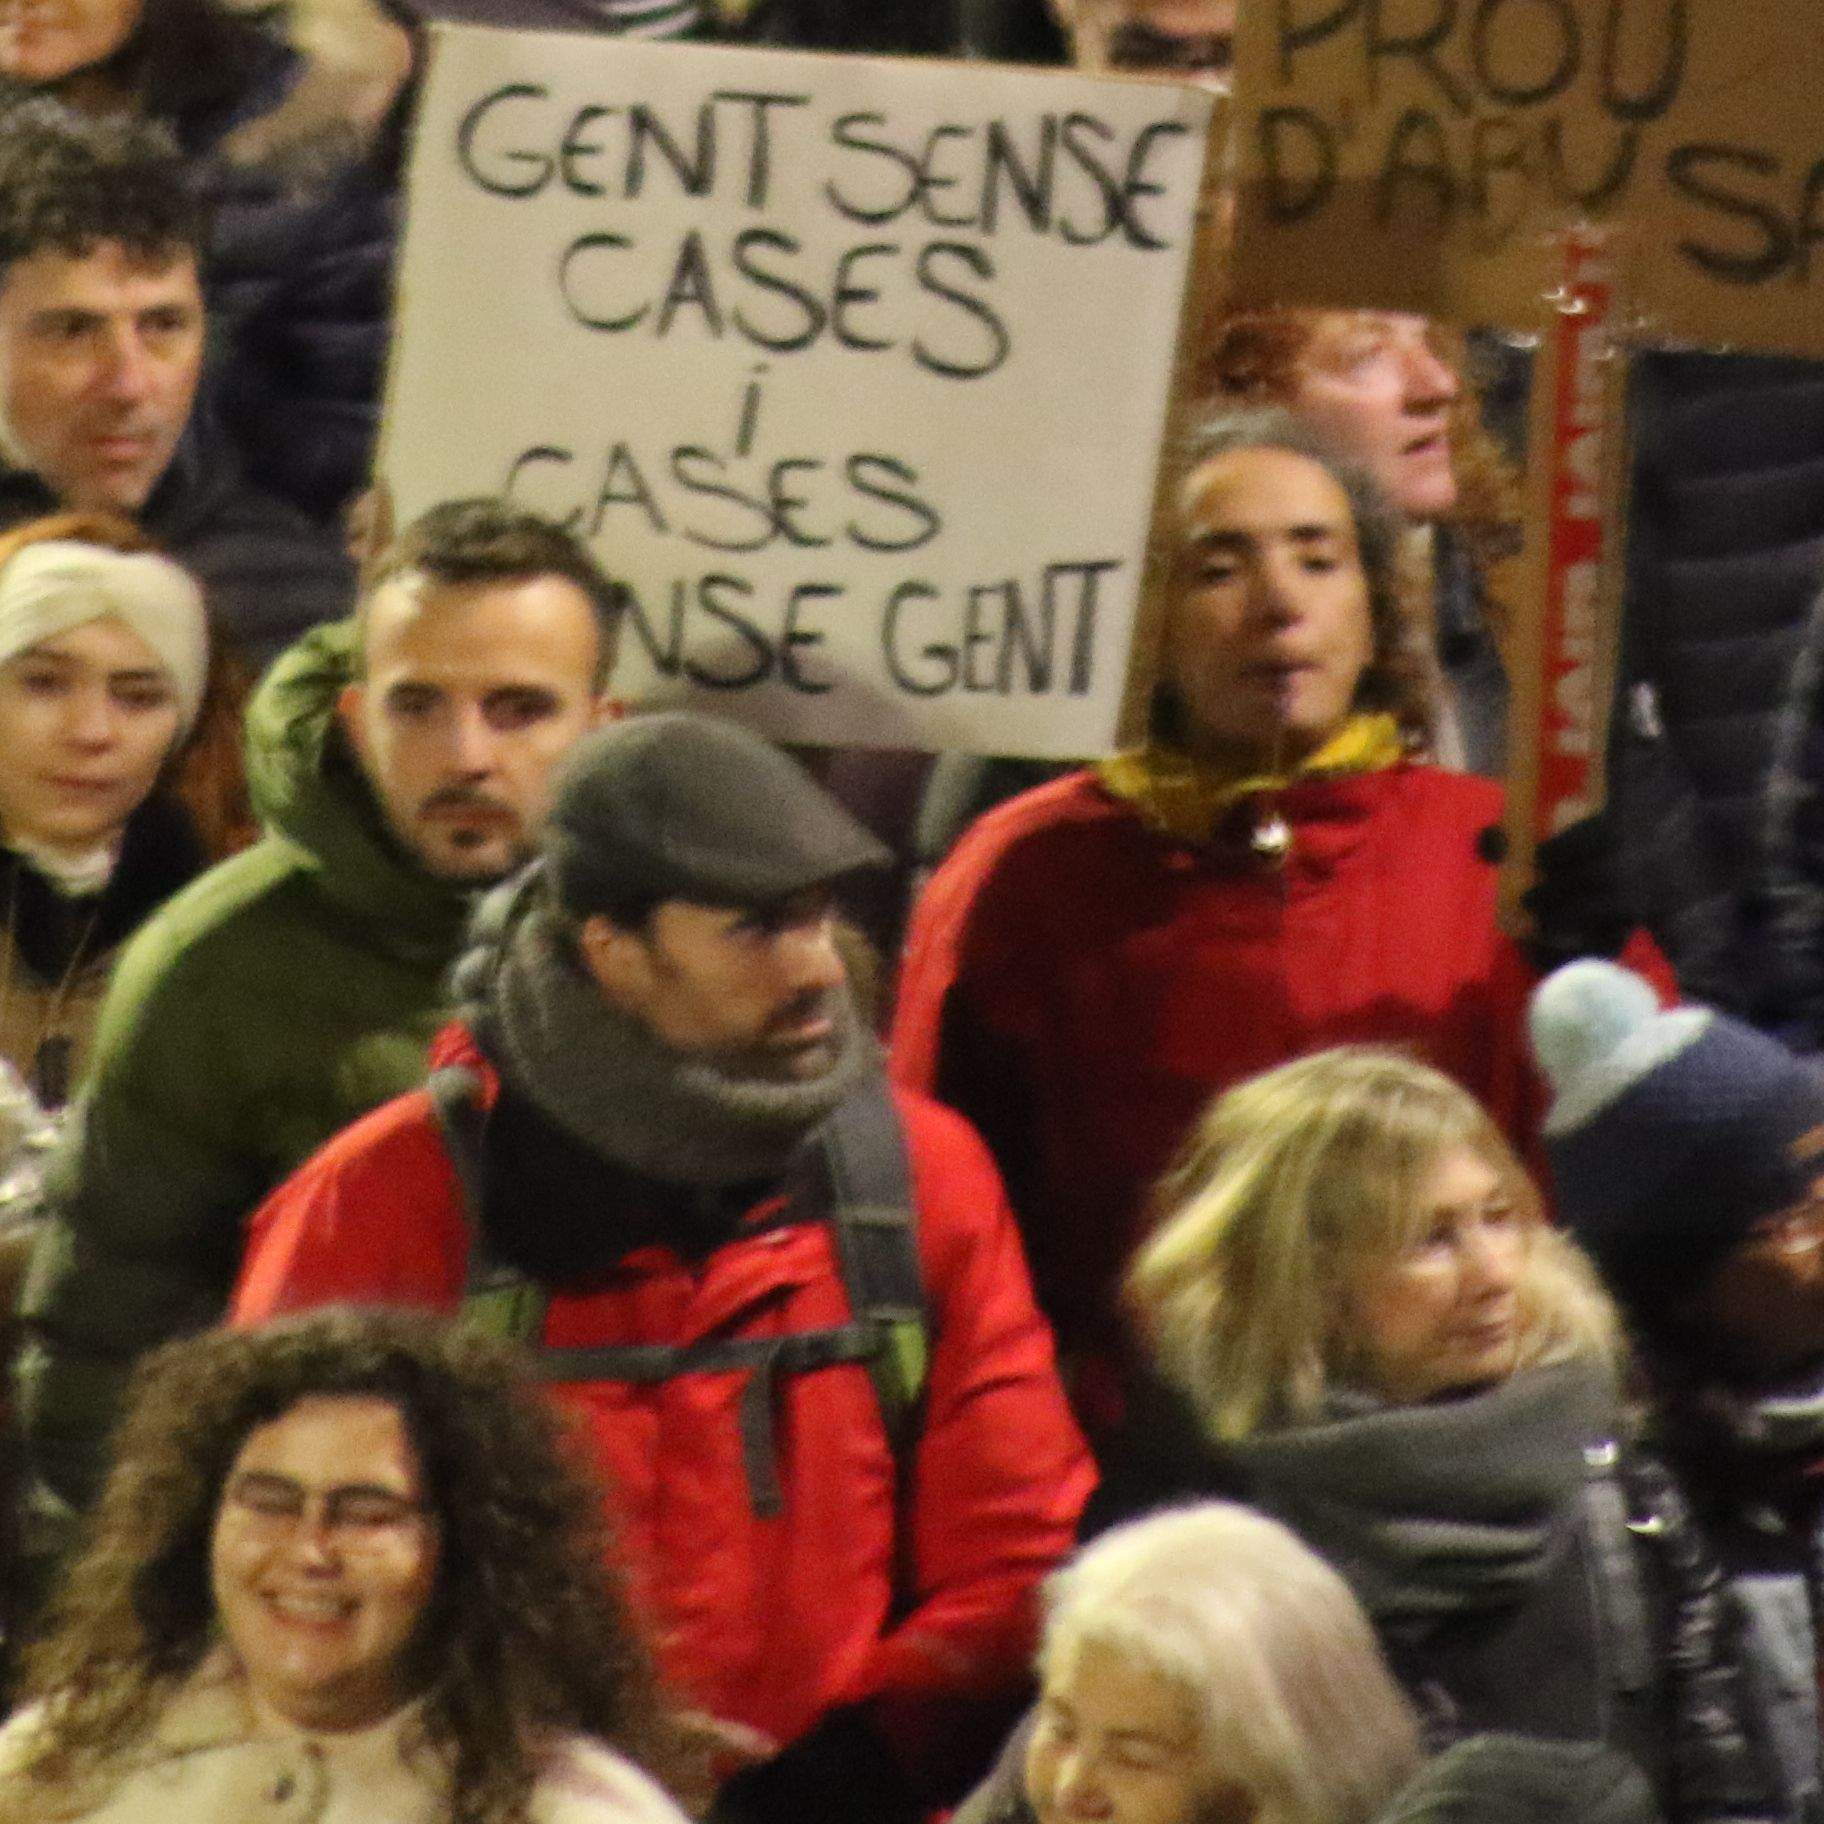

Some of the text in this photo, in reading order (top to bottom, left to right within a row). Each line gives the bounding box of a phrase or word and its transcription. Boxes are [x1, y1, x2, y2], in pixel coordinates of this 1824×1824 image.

[458, 82, 1193, 251] GENT SENSE
[558, 227, 1010, 379] CASES
[504, 441, 942, 554] CASES
[614, 559, 1123, 698] NSE GENT
